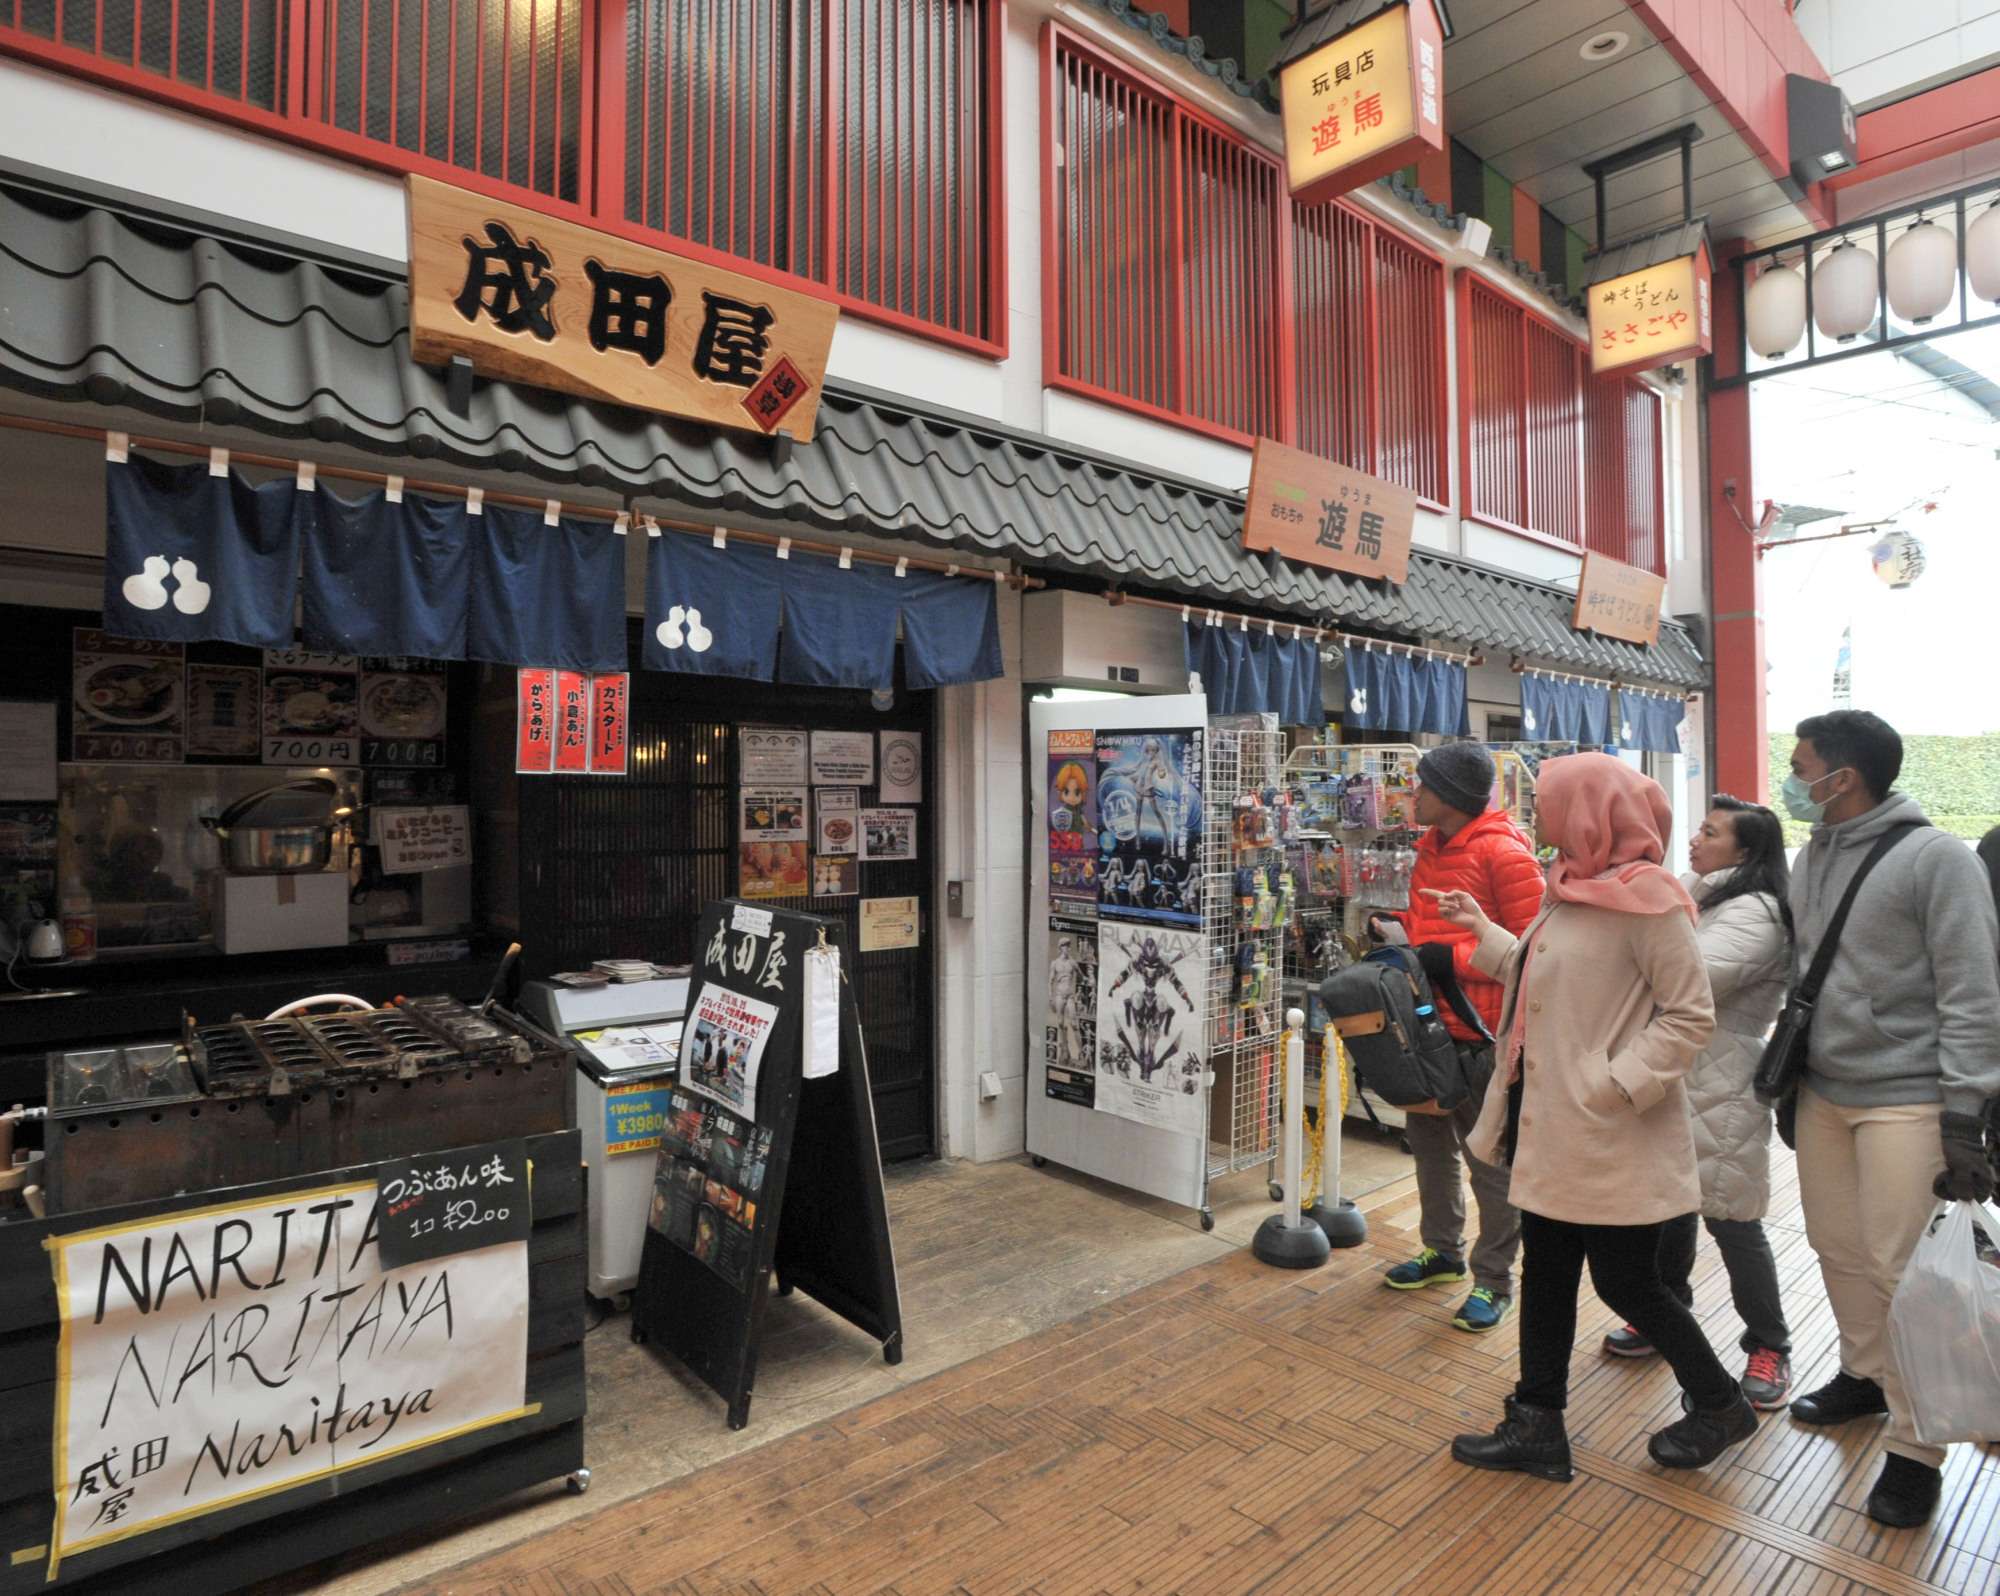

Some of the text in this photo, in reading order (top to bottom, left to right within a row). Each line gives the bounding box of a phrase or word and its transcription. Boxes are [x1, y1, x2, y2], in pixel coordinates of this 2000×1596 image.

[1311, 49, 1375, 96] 玩具店
[1311, 92, 1384, 156] 遊馬
[1327, 90, 1361, 112] ゆうま
[453, 220, 774, 390] 成田屋
[1634, 289, 1680, 312] うどん
[1600, 309, 1689, 350] ささごや
[1340, 485, 1371, 506] ゆうま
[1315, 498, 1384, 560] 遊馬
[529, 684, 544, 741] からあげ
[602, 687, 616, 755] カスタード
[86, 739, 174, 759] 700円
[269, 741, 350, 760] 700円
[367, 742, 436, 762] 700円
[1050, 918, 1071, 930] figma
[705, 918, 788, 991] 成田屋
[617, 1113, 663, 1136] ¥3980
[382, 1153, 514, 1204] つぶあん味
[442, 1199, 510, 1231] ¥200
[101, 1270, 454, 1428] NARITAYA
[184, 1383, 439, 1496] Naritaya
[82, 1486, 135, 1536] 屋
